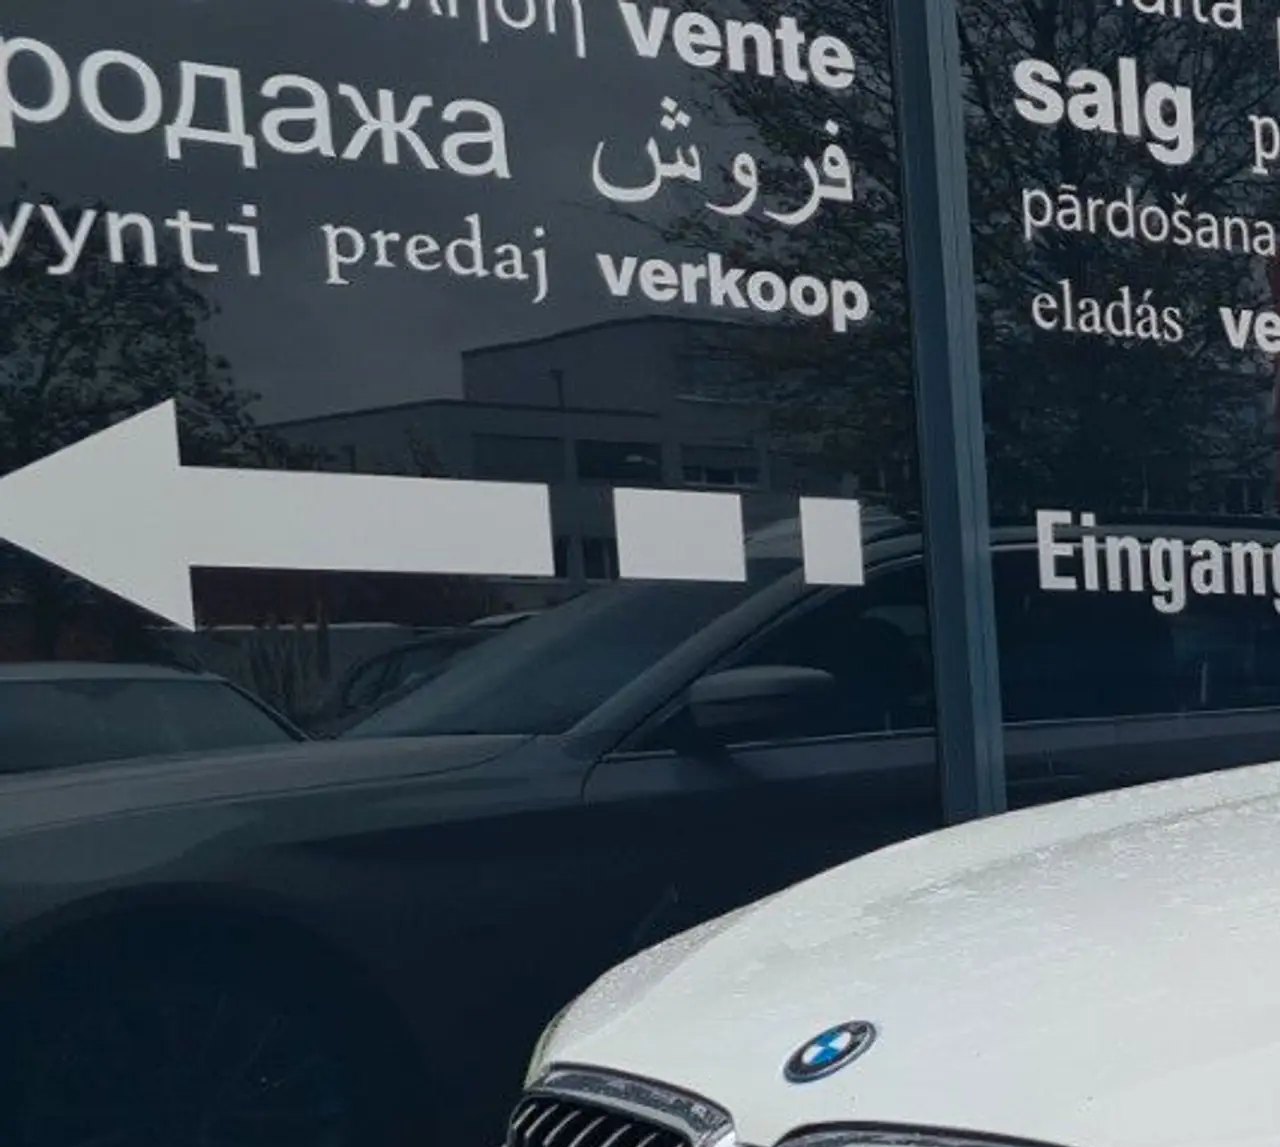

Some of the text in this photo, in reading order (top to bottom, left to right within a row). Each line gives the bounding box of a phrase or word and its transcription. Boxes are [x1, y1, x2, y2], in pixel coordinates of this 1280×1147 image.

[618, 0, 855, 89] vente
[1013, 57, 1195, 165] salg
[1022, 185, 1276, 256] pārdošana
[321, 213, 548, 304] predaj
[596, 252, 870, 333] verkoop
[1031, 280, 1185, 342] eladás
